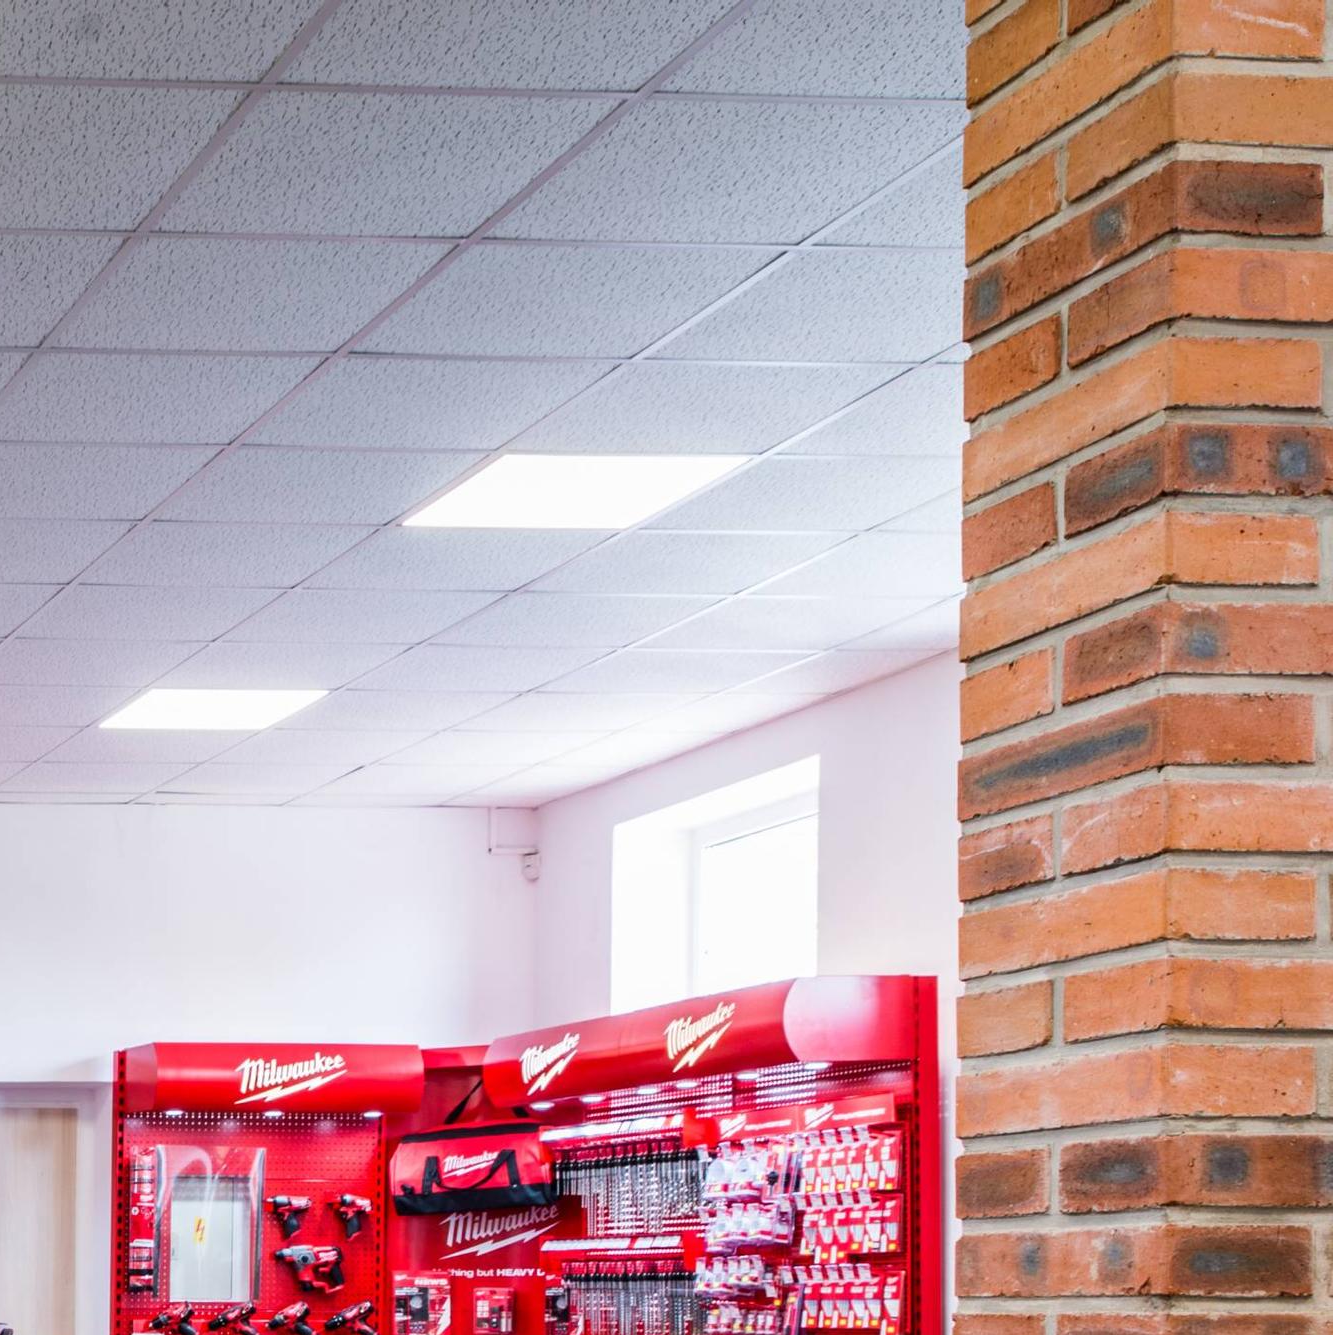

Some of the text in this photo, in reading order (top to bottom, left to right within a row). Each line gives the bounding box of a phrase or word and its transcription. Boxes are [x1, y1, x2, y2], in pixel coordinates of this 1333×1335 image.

[664, 1001, 736, 1062] Milwaukee
[235, 1052, 347, 1095] Milwaukee
[519, 1032, 581, 1084] Milwaukee
[443, 1150, 500, 1173] Milwaukee
[439, 1204, 560, 1248] Milwaukee
[477, 1268, 495, 1277] but
[496, 1268, 534, 1277] HEAVY
